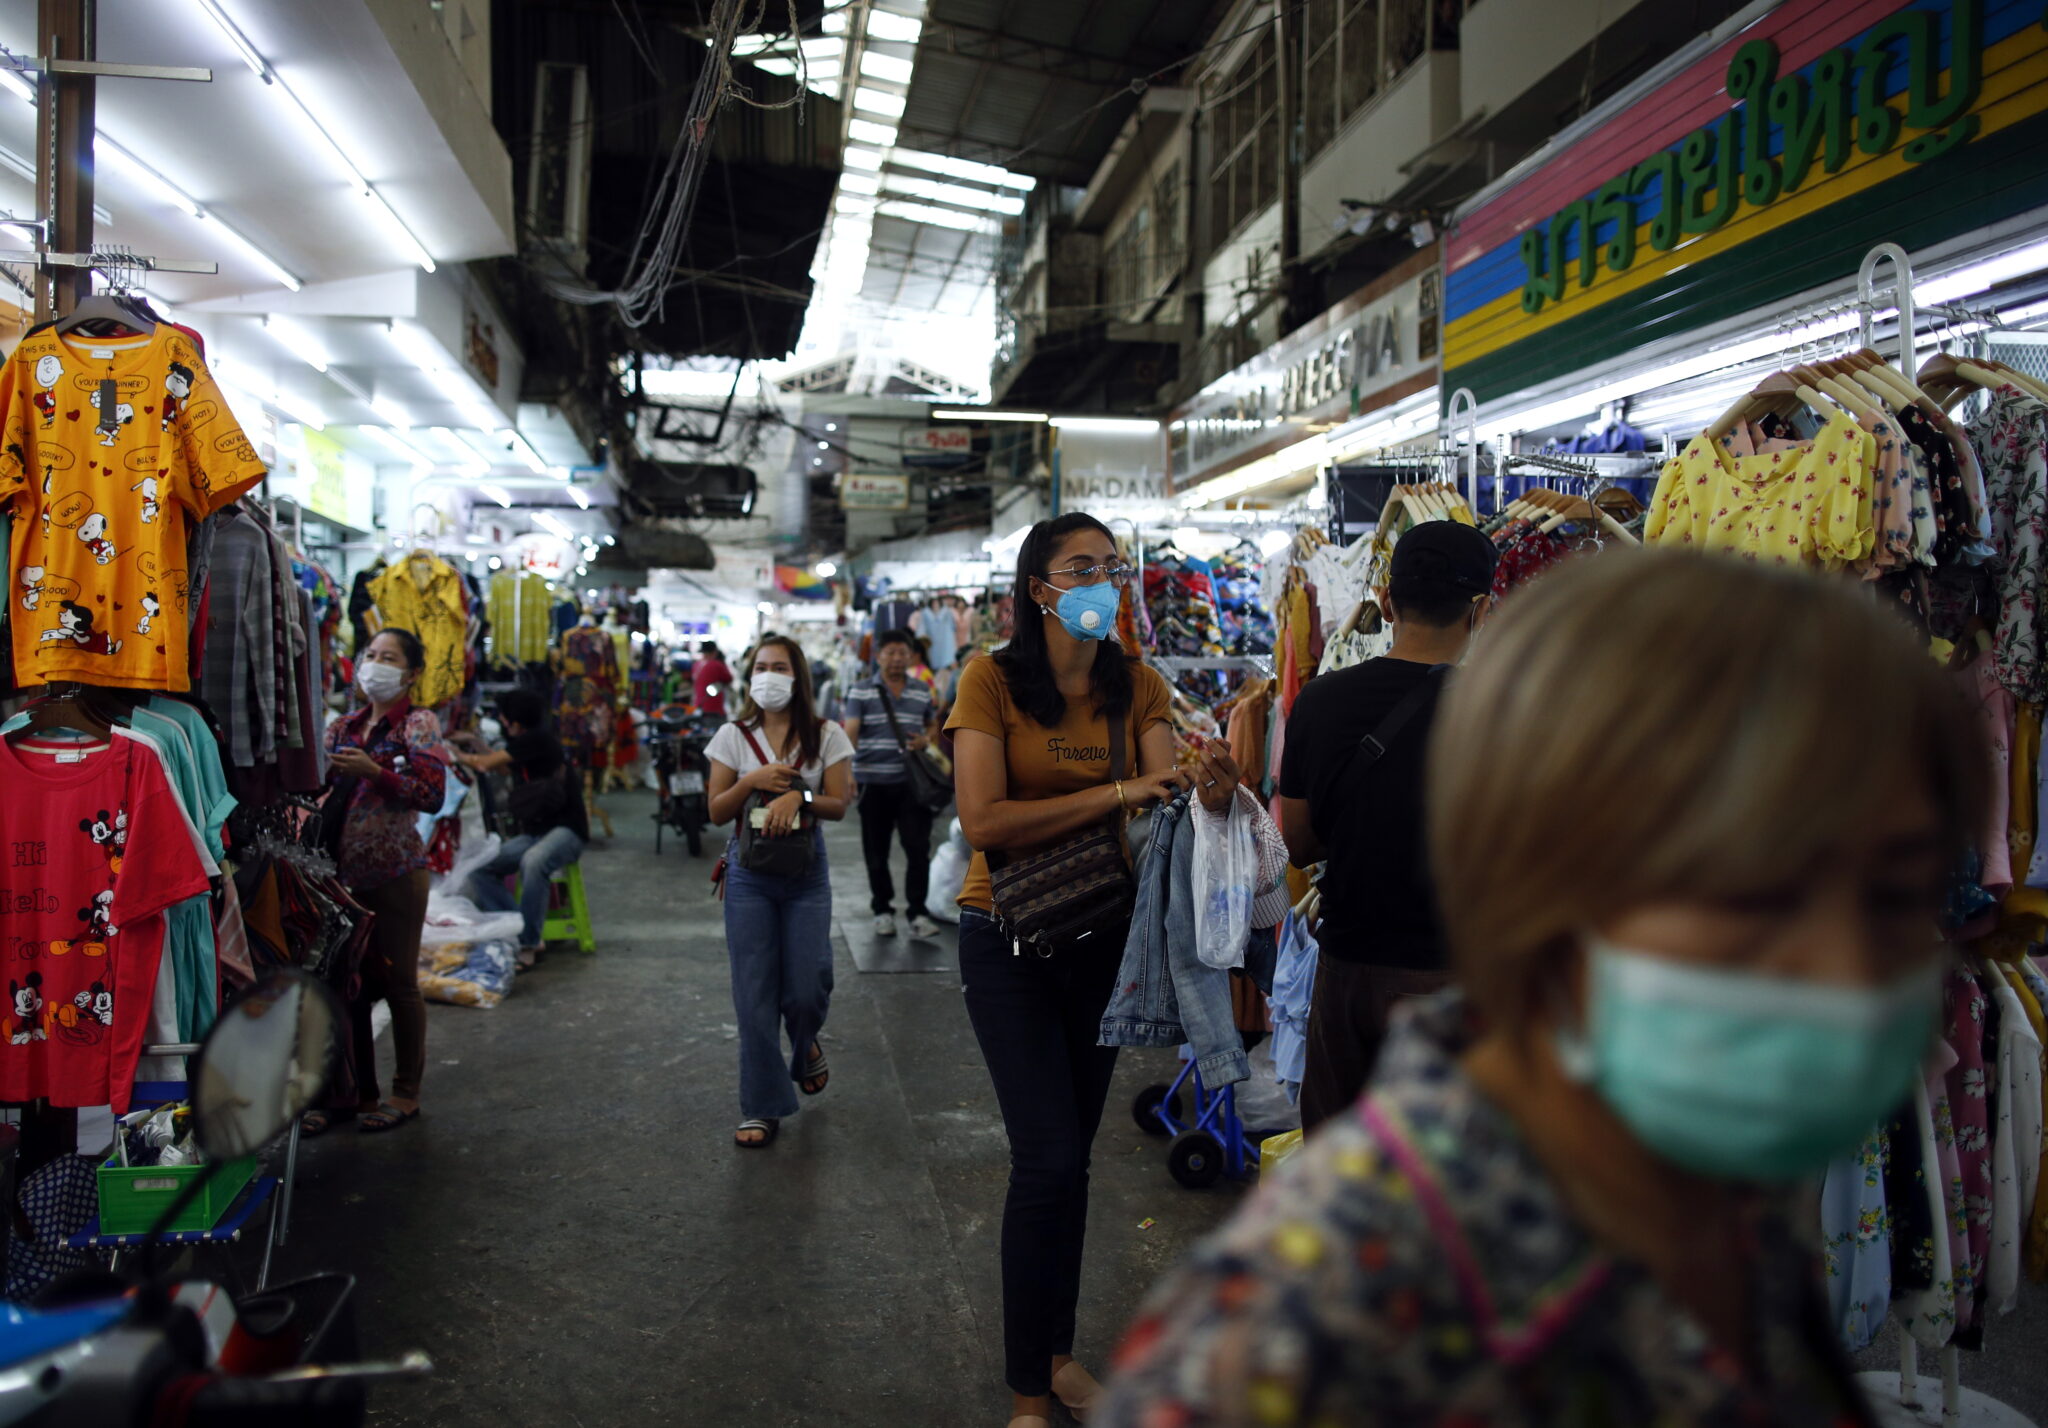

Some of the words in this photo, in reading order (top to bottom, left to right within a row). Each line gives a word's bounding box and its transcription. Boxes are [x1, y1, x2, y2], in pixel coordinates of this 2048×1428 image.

[1064, 476, 1165, 499] MADAM
[61, 502, 81, 518] WOW!
[12, 841, 47, 867] Hi
